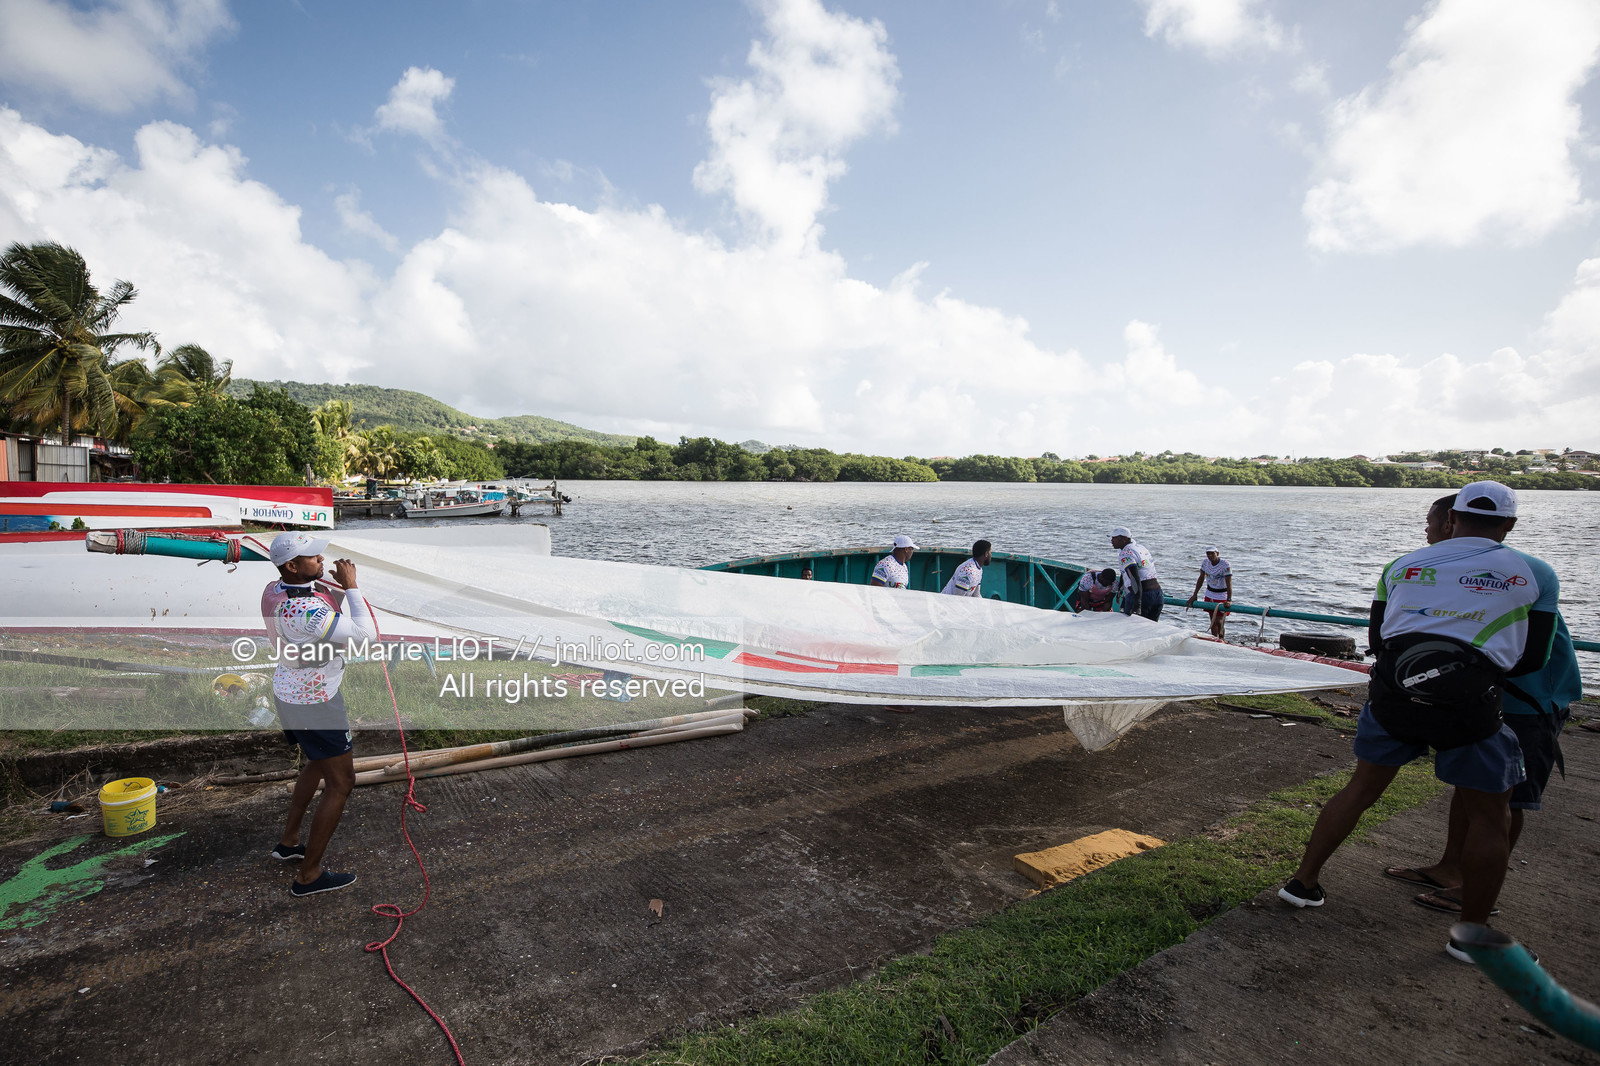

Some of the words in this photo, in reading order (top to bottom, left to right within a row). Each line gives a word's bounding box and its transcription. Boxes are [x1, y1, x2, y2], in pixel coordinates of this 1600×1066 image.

[252, 507, 294, 520] CHANFLOR
[302, 511, 327, 522] UFR
[1391, 567, 1437, 581] UFR
[1458, 575, 1511, 592] CHANFLOR
